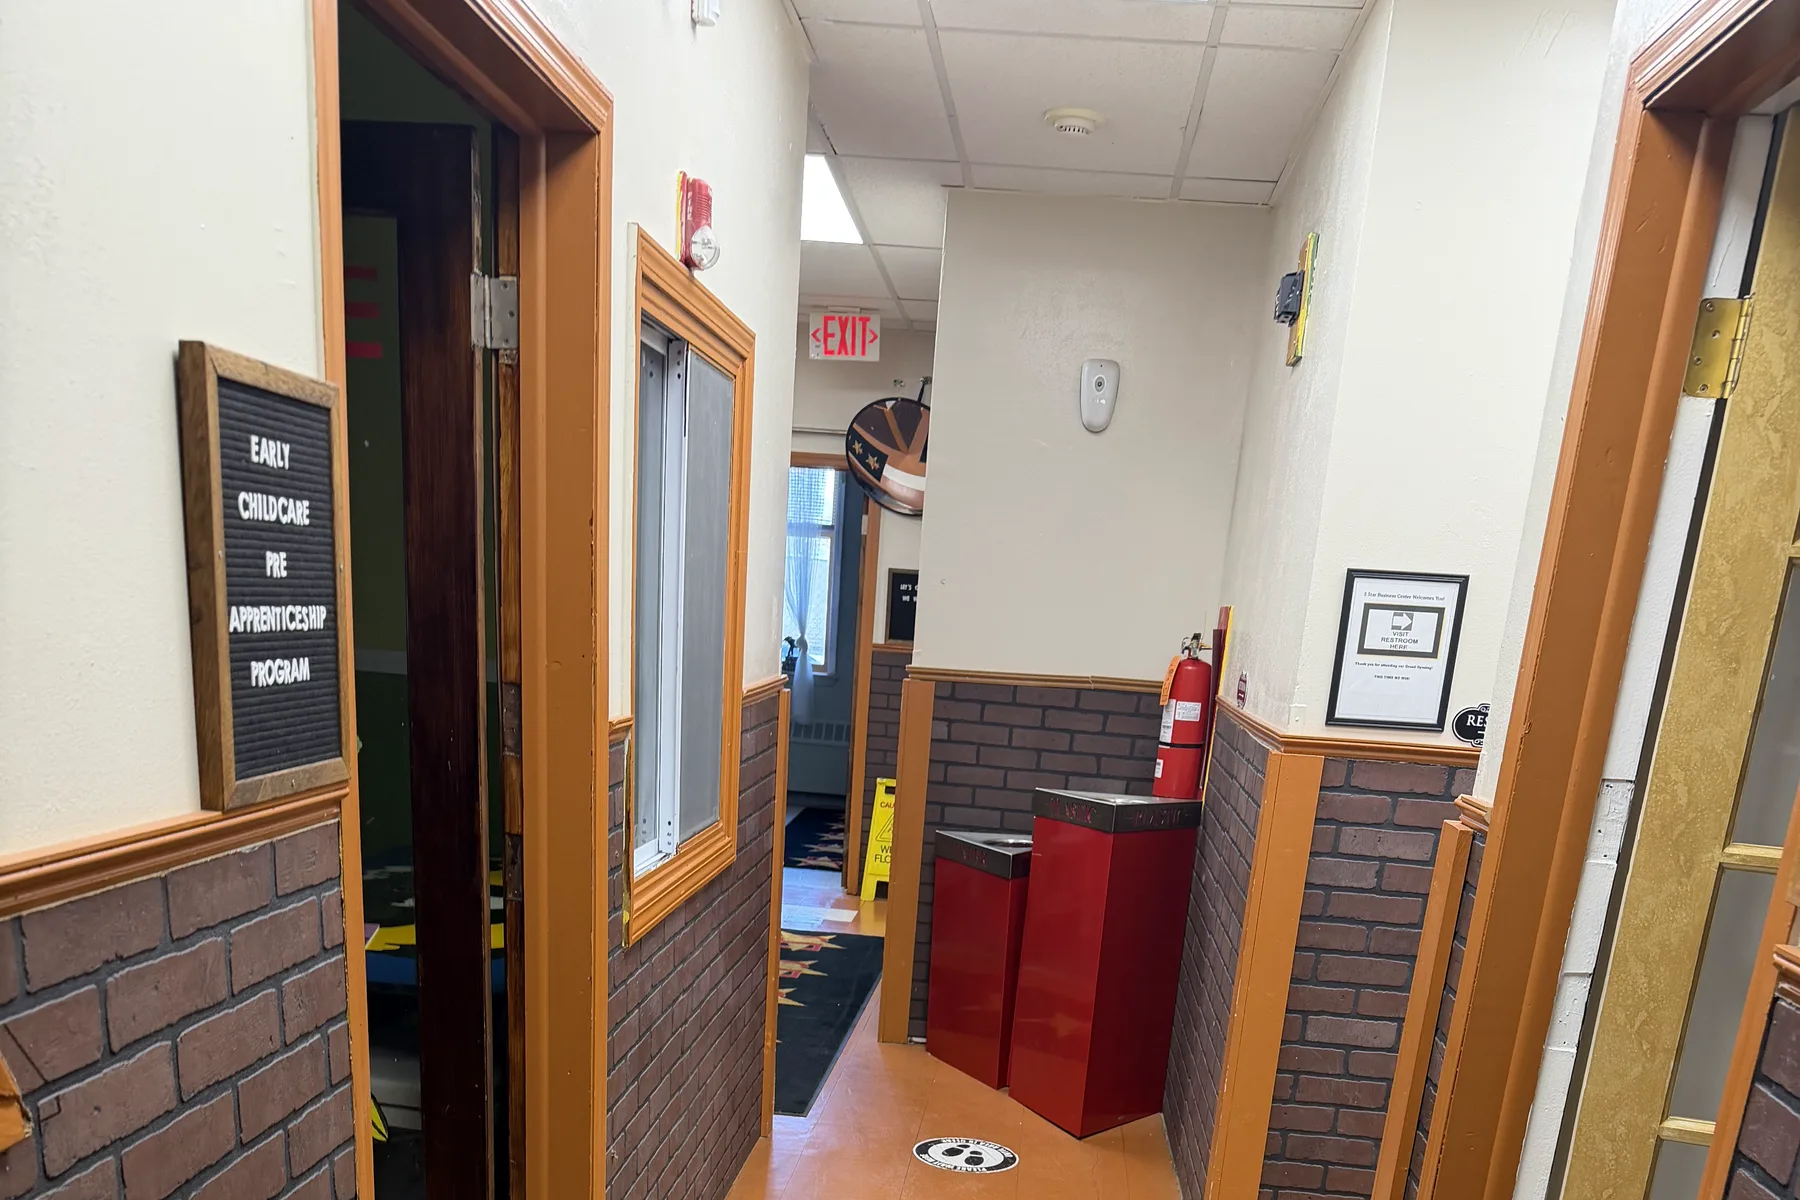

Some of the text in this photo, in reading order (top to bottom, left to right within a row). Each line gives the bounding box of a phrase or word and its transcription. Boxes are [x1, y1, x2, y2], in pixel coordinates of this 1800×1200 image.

[823, 315, 871, 356] EXIT
[250, 434, 290, 469] EARLY
[238, 491, 310, 526] CHILDCARE
[266, 550, 287, 578] PRE
[229, 605, 327, 633] APPRENTICESHIP
[251, 657, 310, 687] PROGRAM
